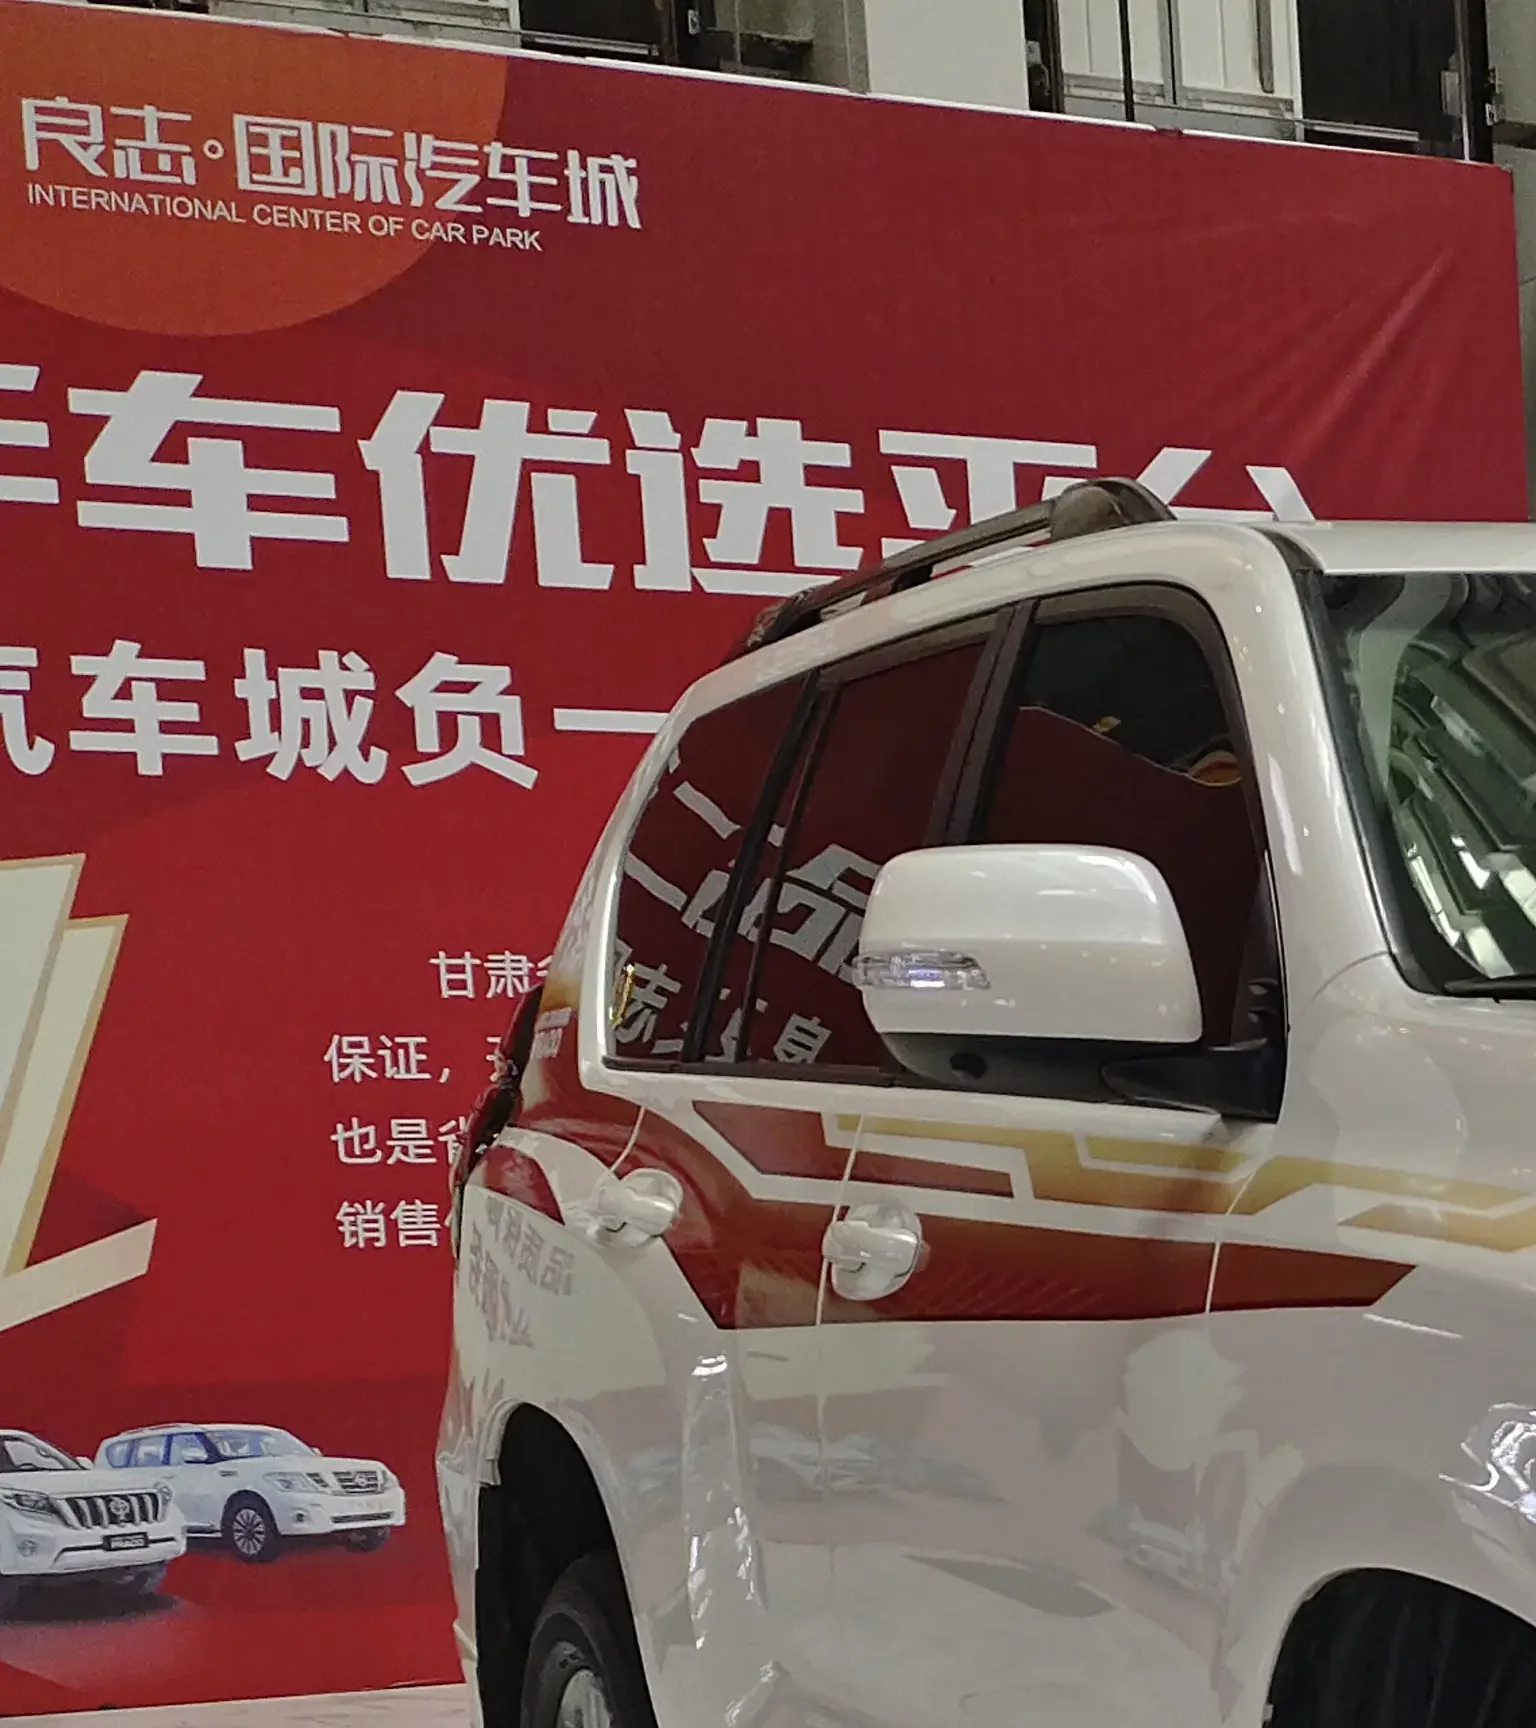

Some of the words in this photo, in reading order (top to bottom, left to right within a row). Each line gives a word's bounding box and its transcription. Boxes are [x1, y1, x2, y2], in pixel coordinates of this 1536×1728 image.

[27, 182, 247, 224] INTERNATIONAL
[252, 203, 363, 234] CENTER
[368, 214, 405, 237] OF
[411, 218, 467, 244] CAR
[473, 225, 543, 252] PARK
[0, 365, 1316, 597] 车优选平
[336, 1199, 451, 1248] 销售
